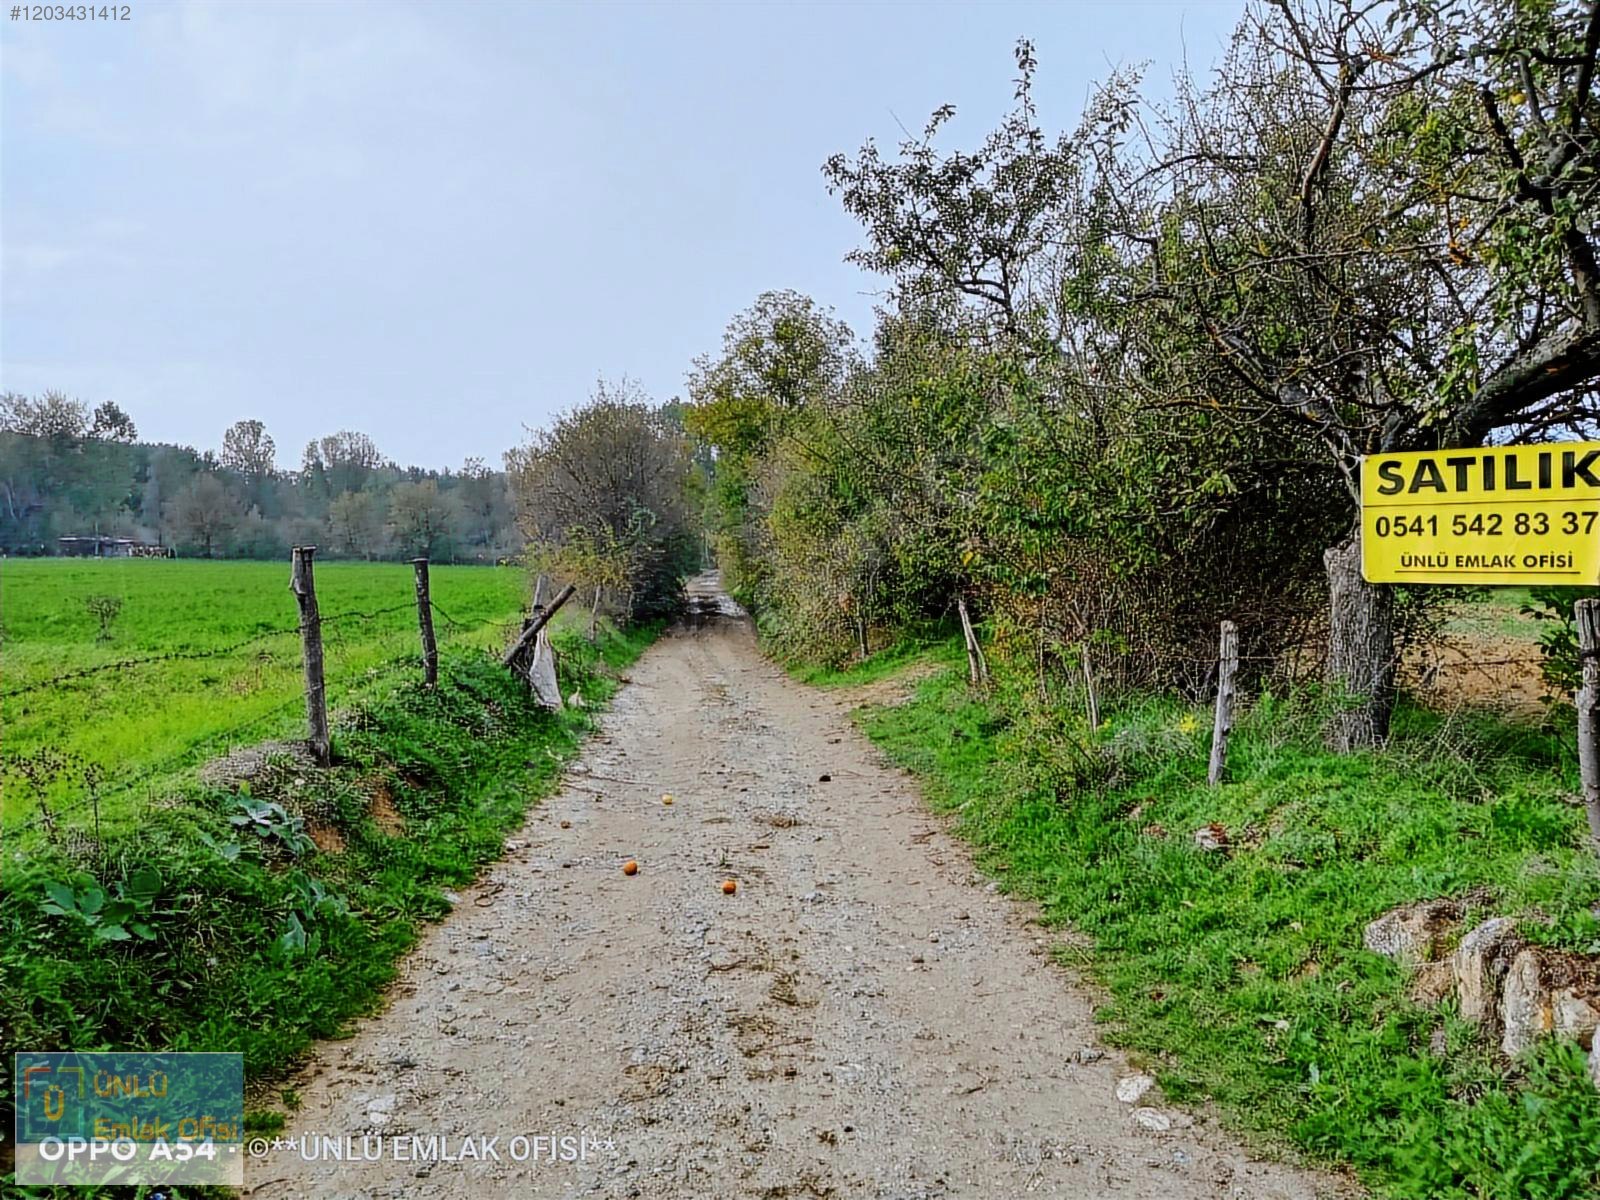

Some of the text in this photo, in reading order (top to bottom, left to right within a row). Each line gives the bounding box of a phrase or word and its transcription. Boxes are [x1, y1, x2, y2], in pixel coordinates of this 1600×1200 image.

[1377, 450, 1600, 496] SATILIK
[1375, 511, 1599, 537] 0541 542 83 37
[1401, 551, 1573, 568] ÜNLÜ EMLAK OFİSİ
